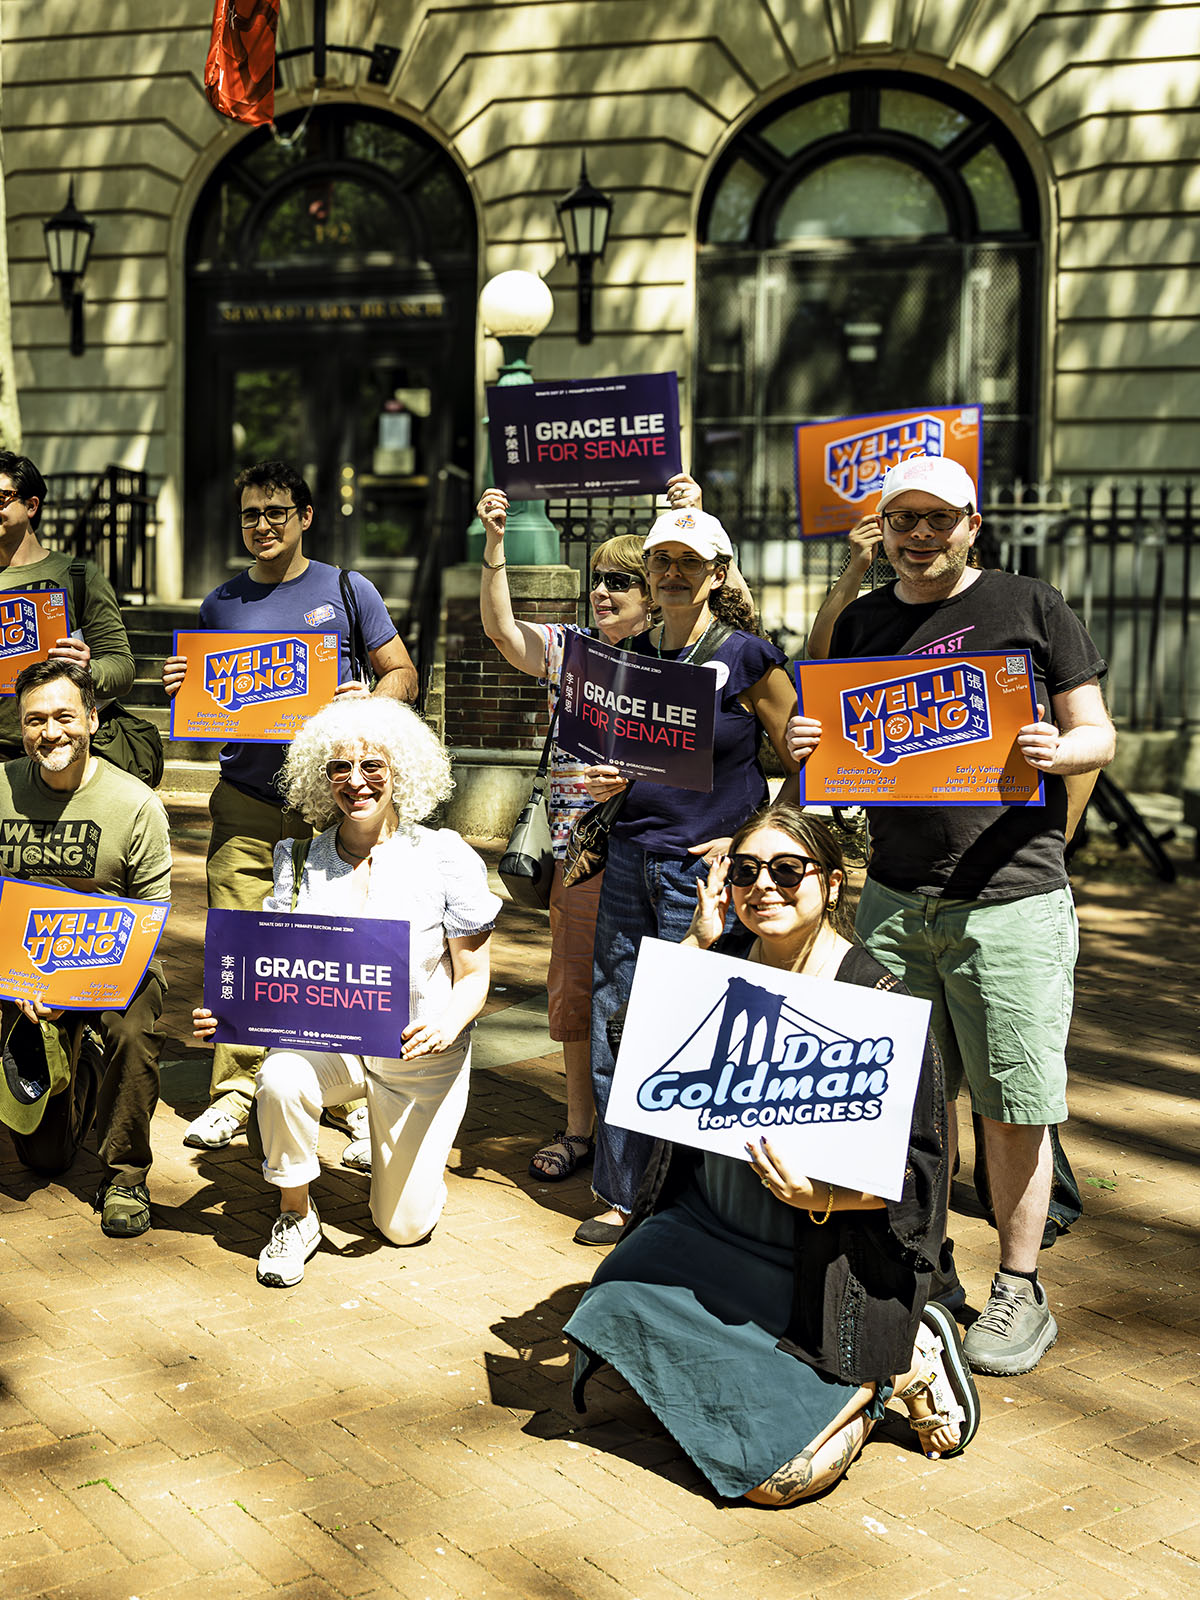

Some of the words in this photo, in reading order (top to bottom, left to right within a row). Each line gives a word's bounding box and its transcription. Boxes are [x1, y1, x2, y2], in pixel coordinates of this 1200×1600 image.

[535, 417, 617, 442] GRACE
[620, 413, 666, 436] LEE
[537, 443, 578, 462] FOR
[584, 436, 666, 460] SENATE
[831, 421, 927, 469] WEI-LI
[947, 635, 965, 653] ST
[209, 643, 294, 678] WEI-LI
[208, 665, 295, 705] TJONG
[237, 680, 248, 690] 65
[847, 670, 967, 722] WEI-LI
[218, 712, 230, 720] Day
[583, 681, 647, 719] GRACE
[652, 702, 697, 728] LEE
[966, 671, 986, 732] 張偉立
[582, 703, 609, 732] FOR
[612, 717, 696, 751] SENATE
[850, 700, 970, 757] TJONG
[889, 741, 927, 753] STATE
[924, 730, 983, 746] ASSEMBLY
[890, 723, 904, 735] 65
[824, 777, 856, 787] Tuesday,
[858, 777, 876, 785] June
[878, 776, 897, 785] 23rd
[837, 767, 865, 775] Election
[866, 767, 882, 777] Day
[946, 776, 964, 785] June
[967, 776, 977, 784] 13
[984, 776, 1003, 784] June
[1004, 776, 1016, 784] 21
[955, 765, 976, 775] Early
[978, 765, 1005, 775] Voting
[3, 823, 88, 844] WEI-LI
[0, 845, 84, 874] TJONG
[33, 911, 122, 936] WEI-LI
[27, 934, 116, 967] TJONG
[56, 943, 68, 952] 65
[9, 968, 30, 978] Election
[30, 972, 42, 981] Day
[220, 955, 235, 1000] 李榮恩
[255, 956, 340, 983] GRACE
[346, 963, 392, 987] LEE
[35, 982, 50, 991] 23rd
[254, 981, 299, 1005] FOR
[305, 984, 392, 1012] SENATE
[778, 1034, 893, 1071] Dan
[639, 1061, 888, 1109] Goldman
[700, 1108, 739, 1129] for
[740, 1100, 881, 1125] CONGRESS
